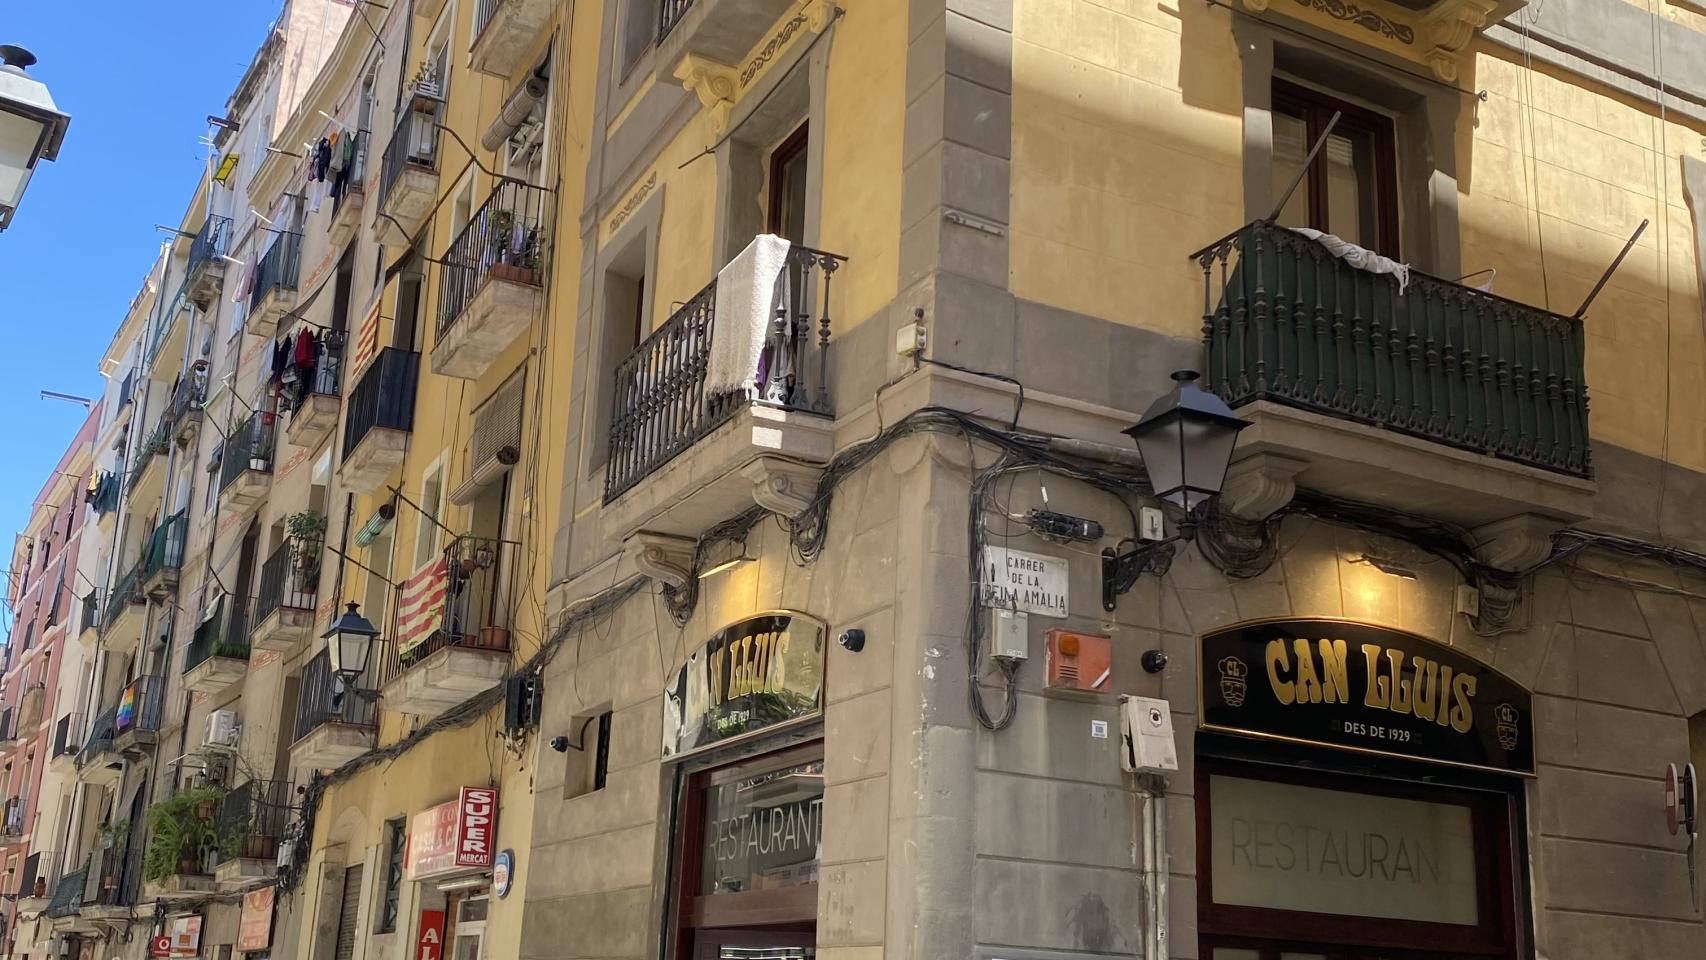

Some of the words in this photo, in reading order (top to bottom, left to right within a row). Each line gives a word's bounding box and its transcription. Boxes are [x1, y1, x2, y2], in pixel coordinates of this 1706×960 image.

[1007, 556, 1044, 573] CARRER
[1012, 573, 1023, 584] DE
[1028, 575, 1039, 587] LA
[1024, 587, 1065, 610] AMÀLIA
[728, 632, 790, 700] LLUIS
[1265, 638, 1349, 706] CAN
[1361, 643, 1477, 734] LLUIS
[1344, 721, 1366, 736] DES
[1370, 725, 1385, 738] DE
[1389, 728, 1410, 742] 1929
[463, 791, 491, 853] SUPER
[709, 799, 824, 862] RESTAURANT
[460, 853, 488, 864] MERCAT
